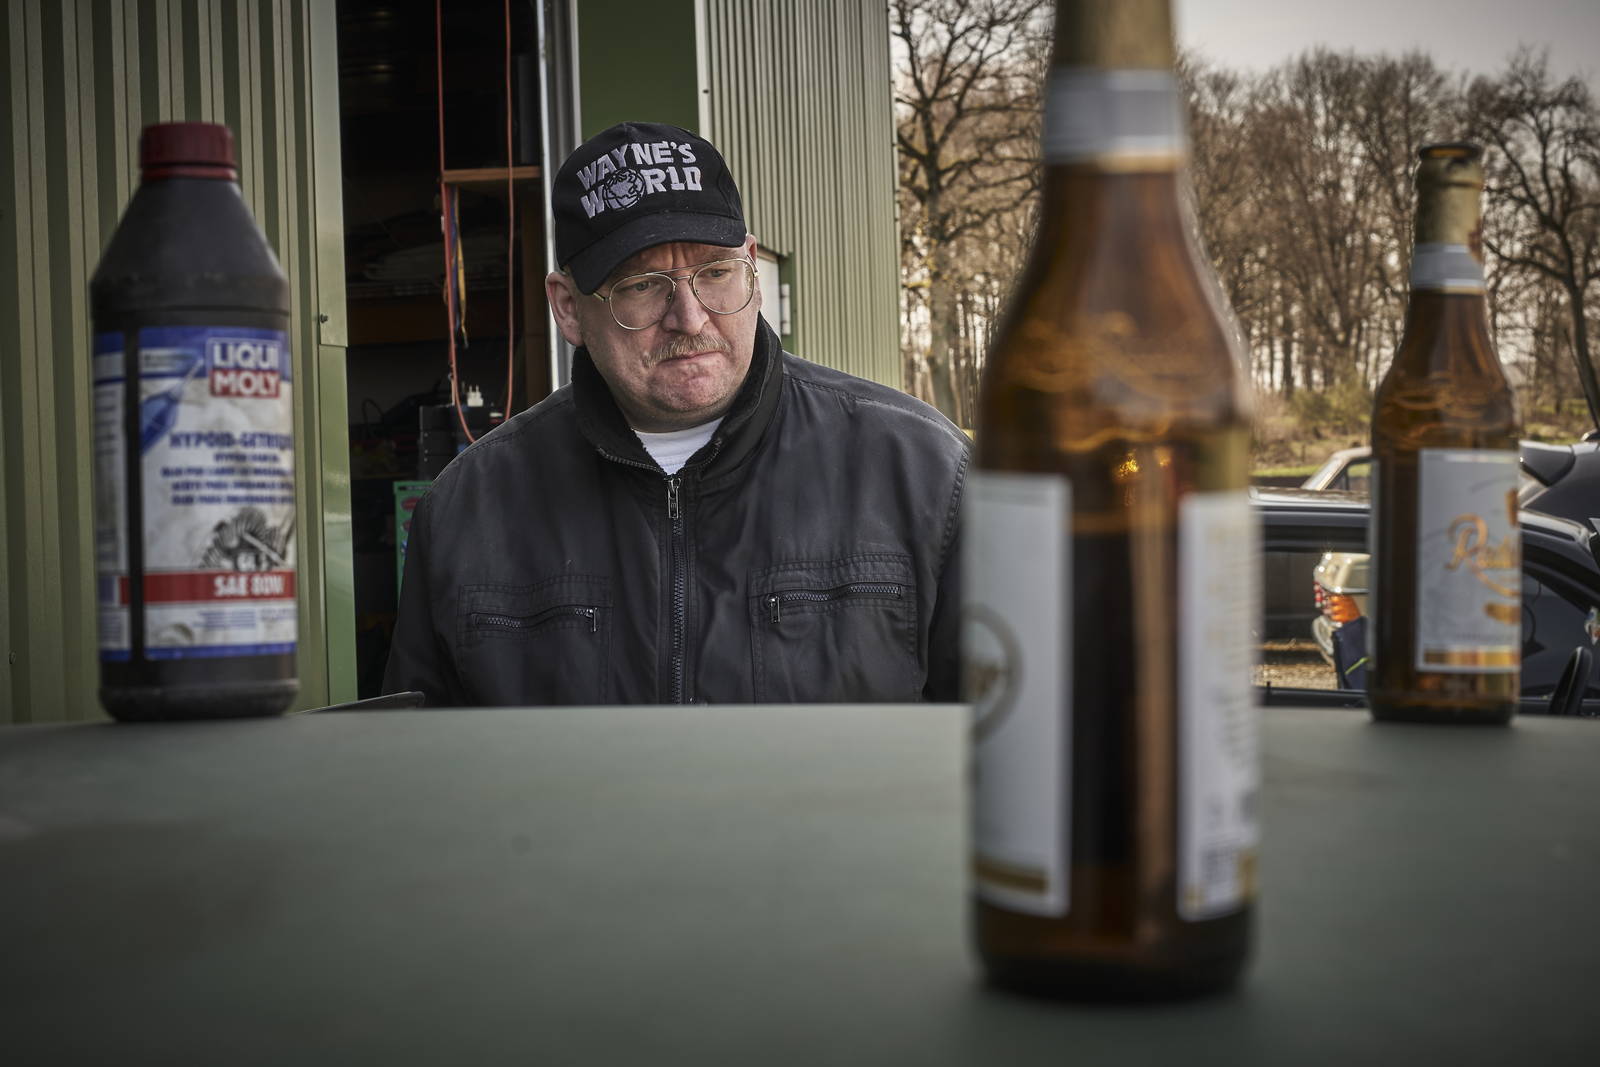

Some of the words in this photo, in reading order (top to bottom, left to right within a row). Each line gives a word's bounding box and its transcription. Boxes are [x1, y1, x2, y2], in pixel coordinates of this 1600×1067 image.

[576, 141, 697, 191] WAYNE'S
[580, 166, 702, 219] WORLD
[213, 343, 279, 369] LIQUI
[213, 371, 279, 395] MOLY
[214, 576, 248, 597] SAE
